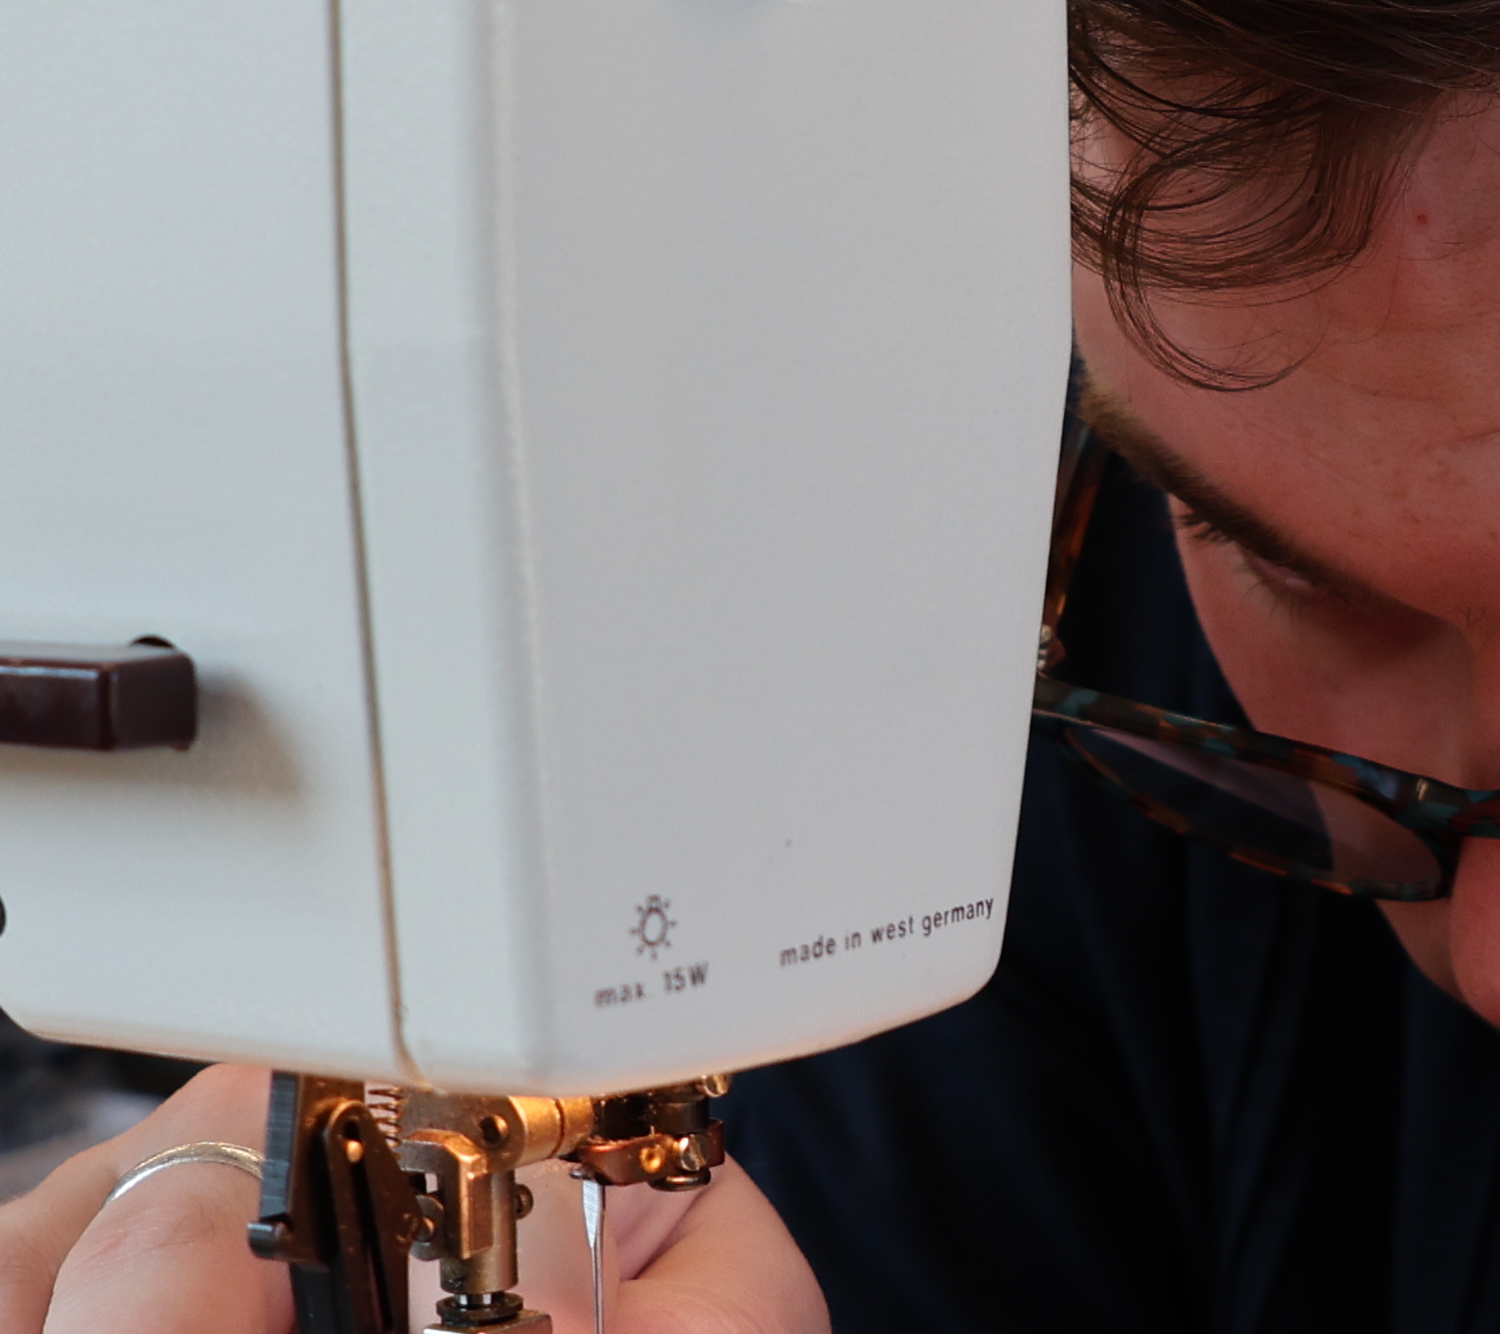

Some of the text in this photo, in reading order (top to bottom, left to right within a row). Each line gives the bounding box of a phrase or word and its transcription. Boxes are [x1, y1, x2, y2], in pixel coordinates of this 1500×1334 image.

[779, 897, 994, 967] made in west germany
